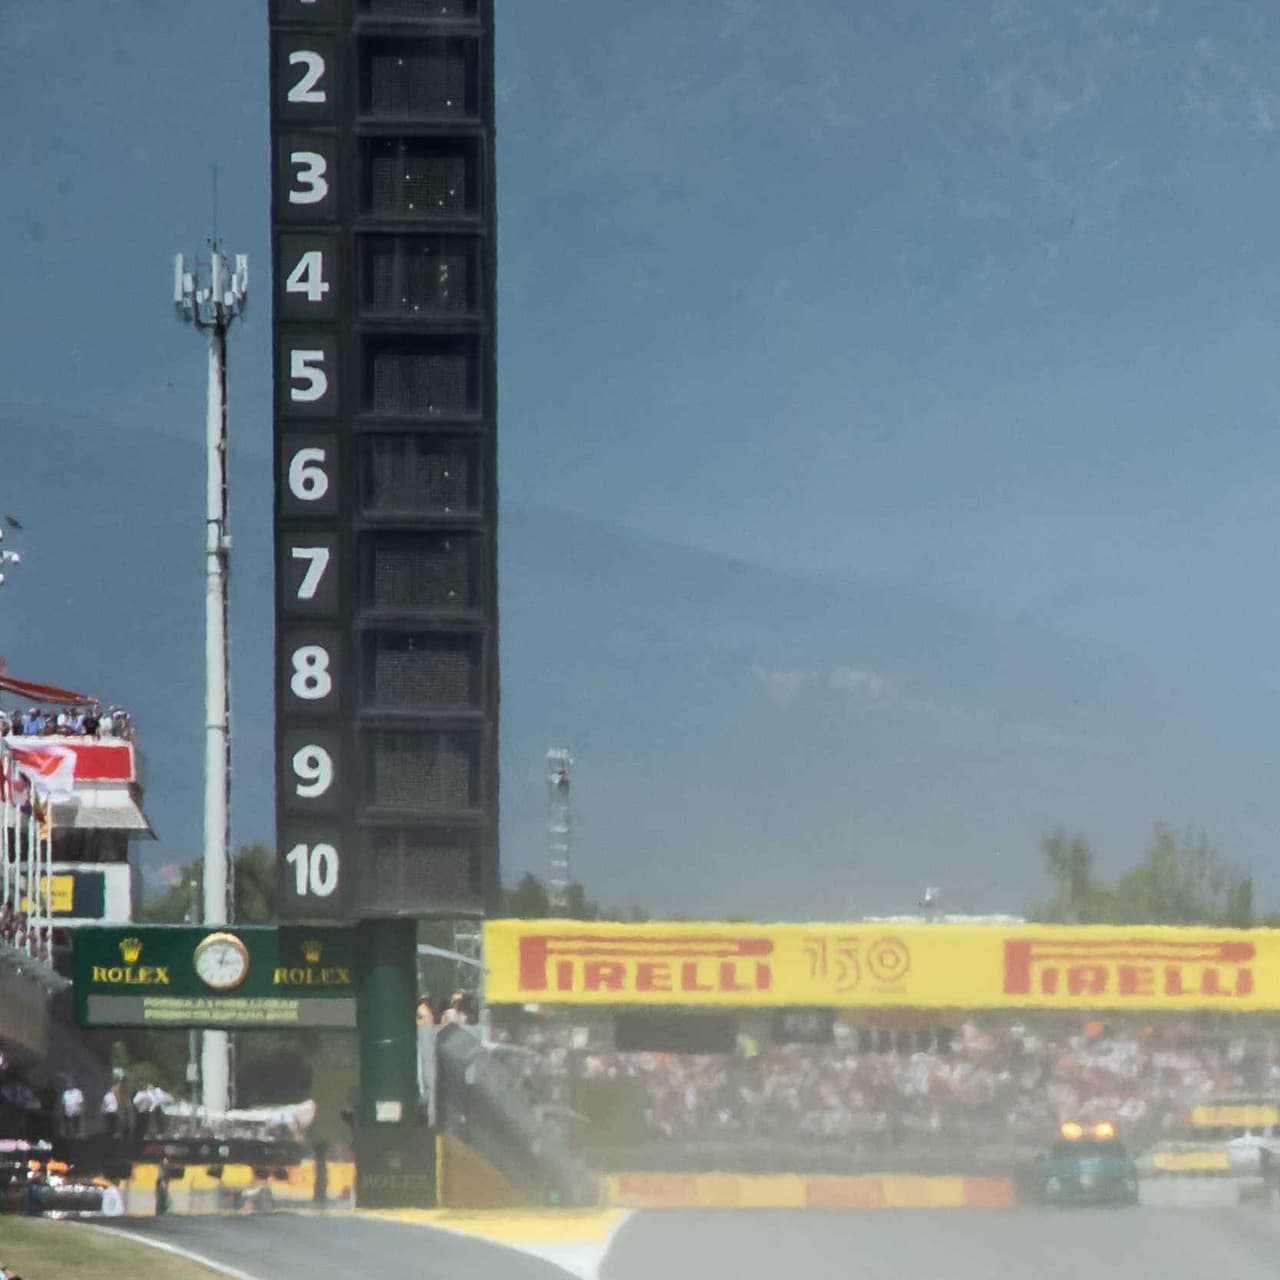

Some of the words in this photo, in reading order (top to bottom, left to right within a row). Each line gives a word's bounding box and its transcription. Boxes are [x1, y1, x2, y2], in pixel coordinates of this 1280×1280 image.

[287, 50, 326, 102] 2
[288, 152, 328, 204] 3
[286, 251, 329, 301] 4
[290, 350, 327, 401] 5
[289, 448, 328, 500] 6
[291, 547, 329, 599] 7
[290, 645, 332, 700] 8
[292, 744, 332, 797] 9
[286, 843, 338, 897] 10
[92, 966, 170, 985] ROLEX
[272, 967, 351, 985] ROLEX
[519, 935, 773, 993] PIRELLI
[1003, 939, 1256, 996] PIRELLI
